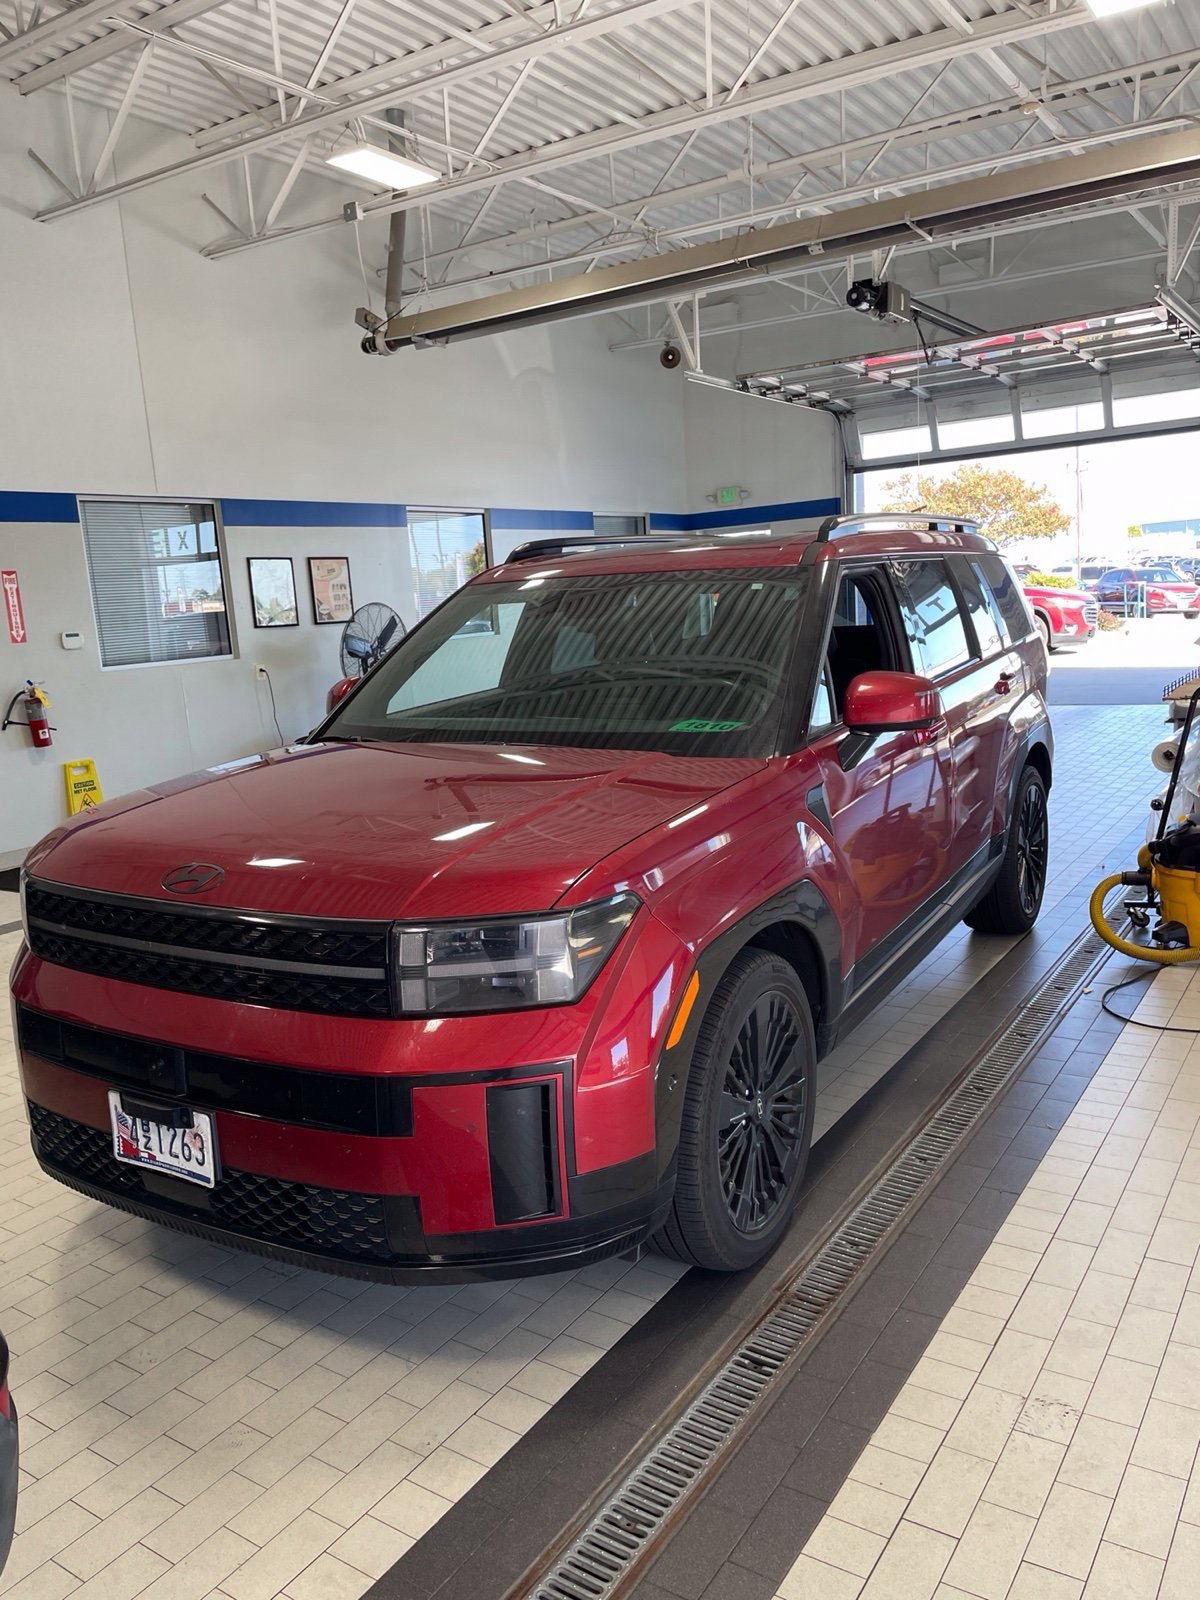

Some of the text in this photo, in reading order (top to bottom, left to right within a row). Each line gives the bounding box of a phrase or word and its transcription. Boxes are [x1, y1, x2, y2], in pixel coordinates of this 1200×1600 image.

[4, 577, 16, 585] FIRE
[9, 587, 21, 638] EXTINGUISHER
[74, 781, 94, 789] CAUTION
